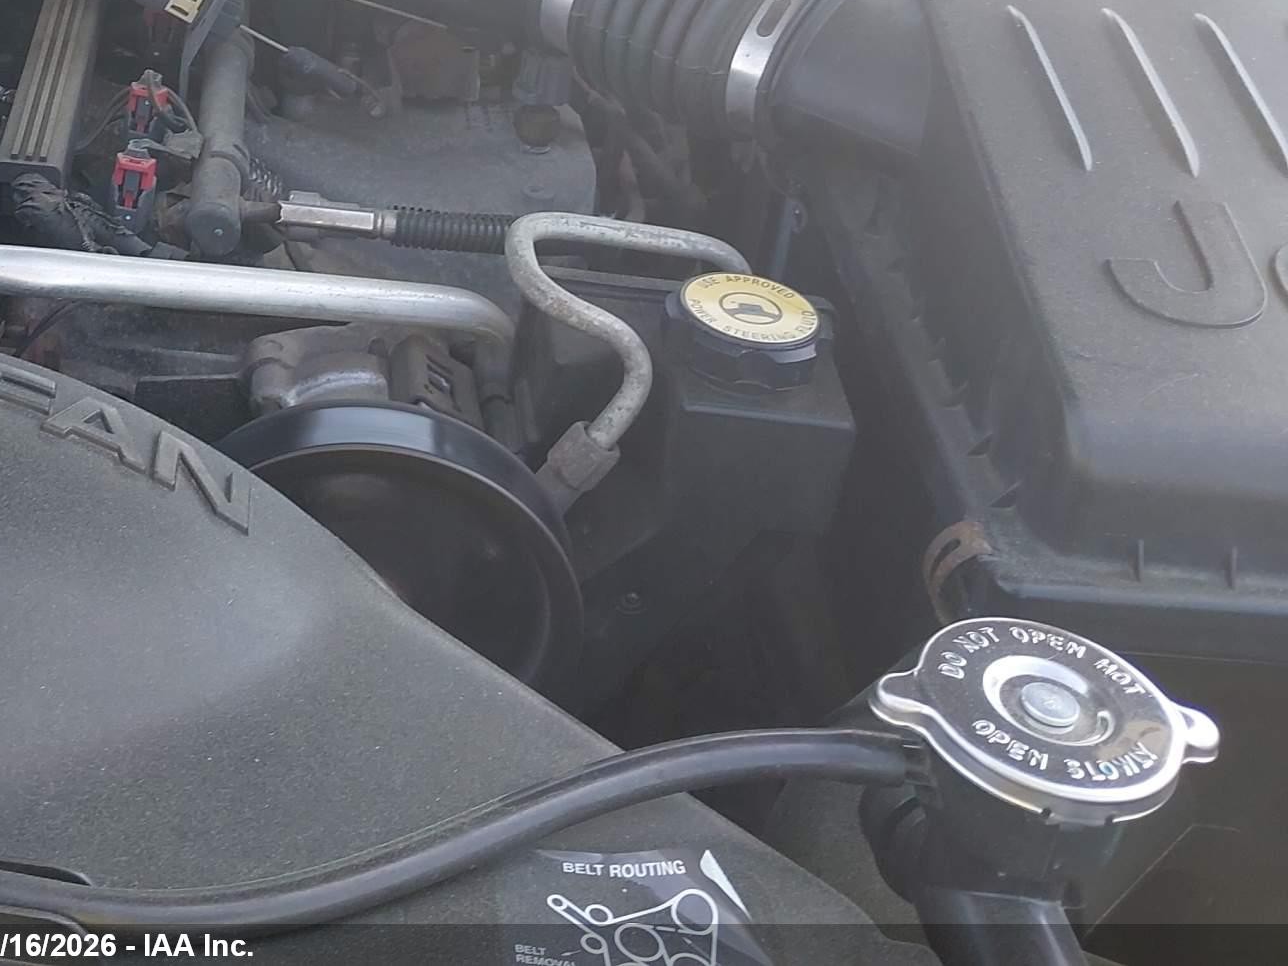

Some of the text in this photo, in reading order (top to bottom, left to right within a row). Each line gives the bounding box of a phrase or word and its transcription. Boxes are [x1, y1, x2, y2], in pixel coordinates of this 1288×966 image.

[725, 274, 795, 300] APPROVED
[688, 298, 718, 325] POWER
[722, 325, 797, 342] STEERING
[938, 651, 968, 680] DO
[953, 626, 1001, 654] NOT
[1009, 626, 1087, 660] OPEN
[971, 719, 1049, 771] OPEN
[562, 859, 687, 879] BELT ROUTING
[514, 943, 547, 956] BELT
